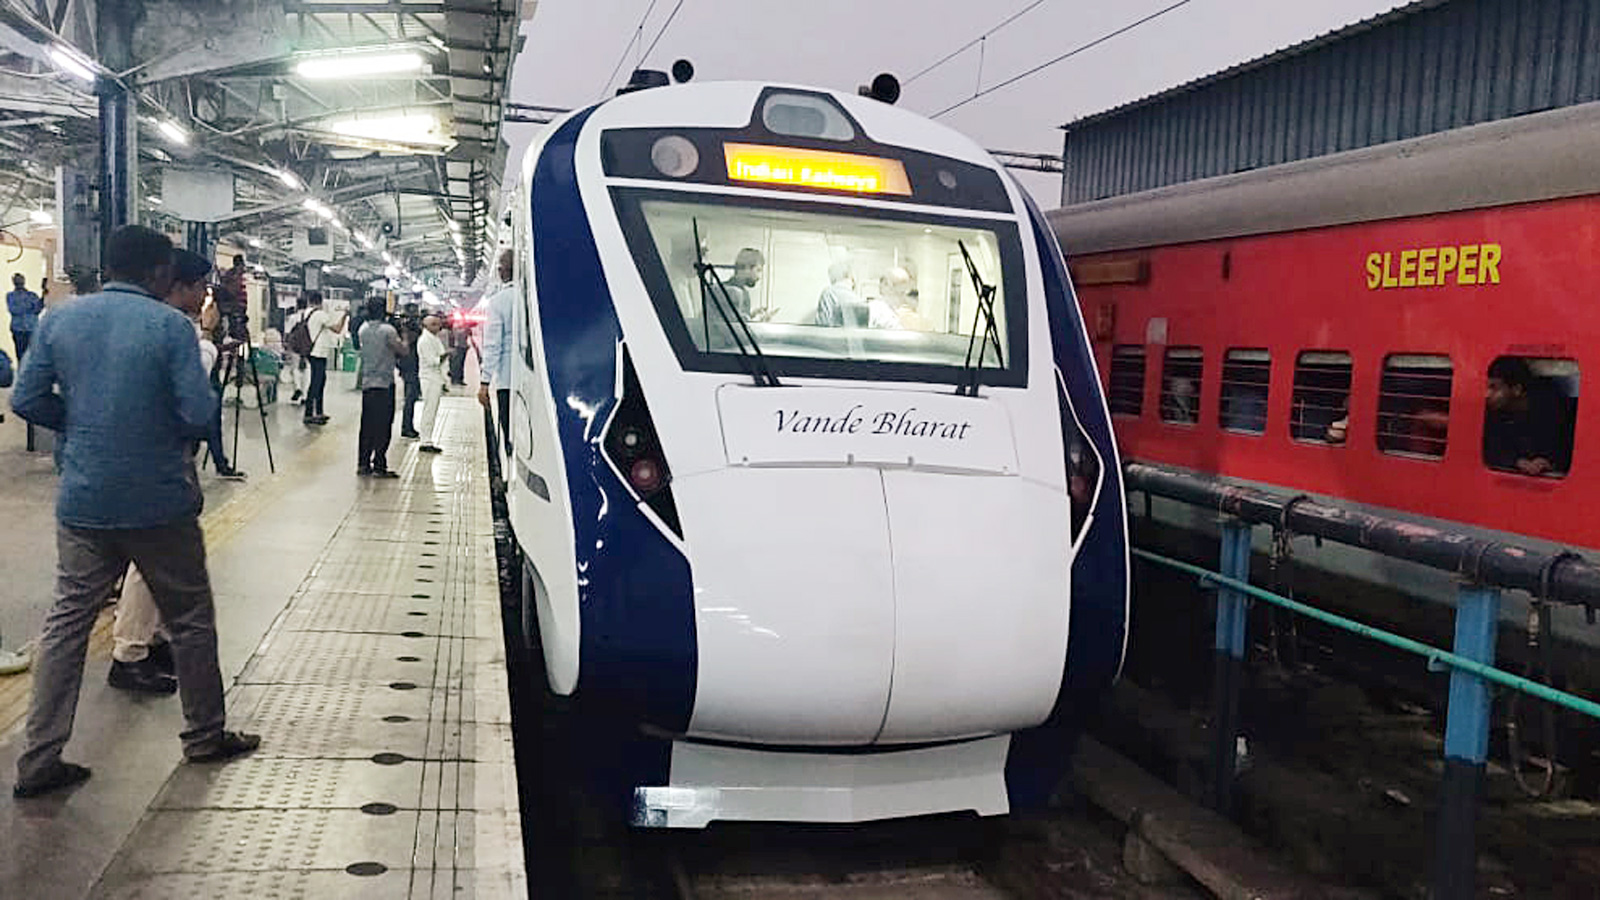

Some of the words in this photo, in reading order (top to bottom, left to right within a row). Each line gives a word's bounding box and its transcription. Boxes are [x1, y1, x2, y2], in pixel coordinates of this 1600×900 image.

[736, 160, 793, 180] Indian
[1366, 244, 1502, 289] SLEEPER
[775, 404, 863, 434] Vande
[871, 407, 971, 440] Bharat
